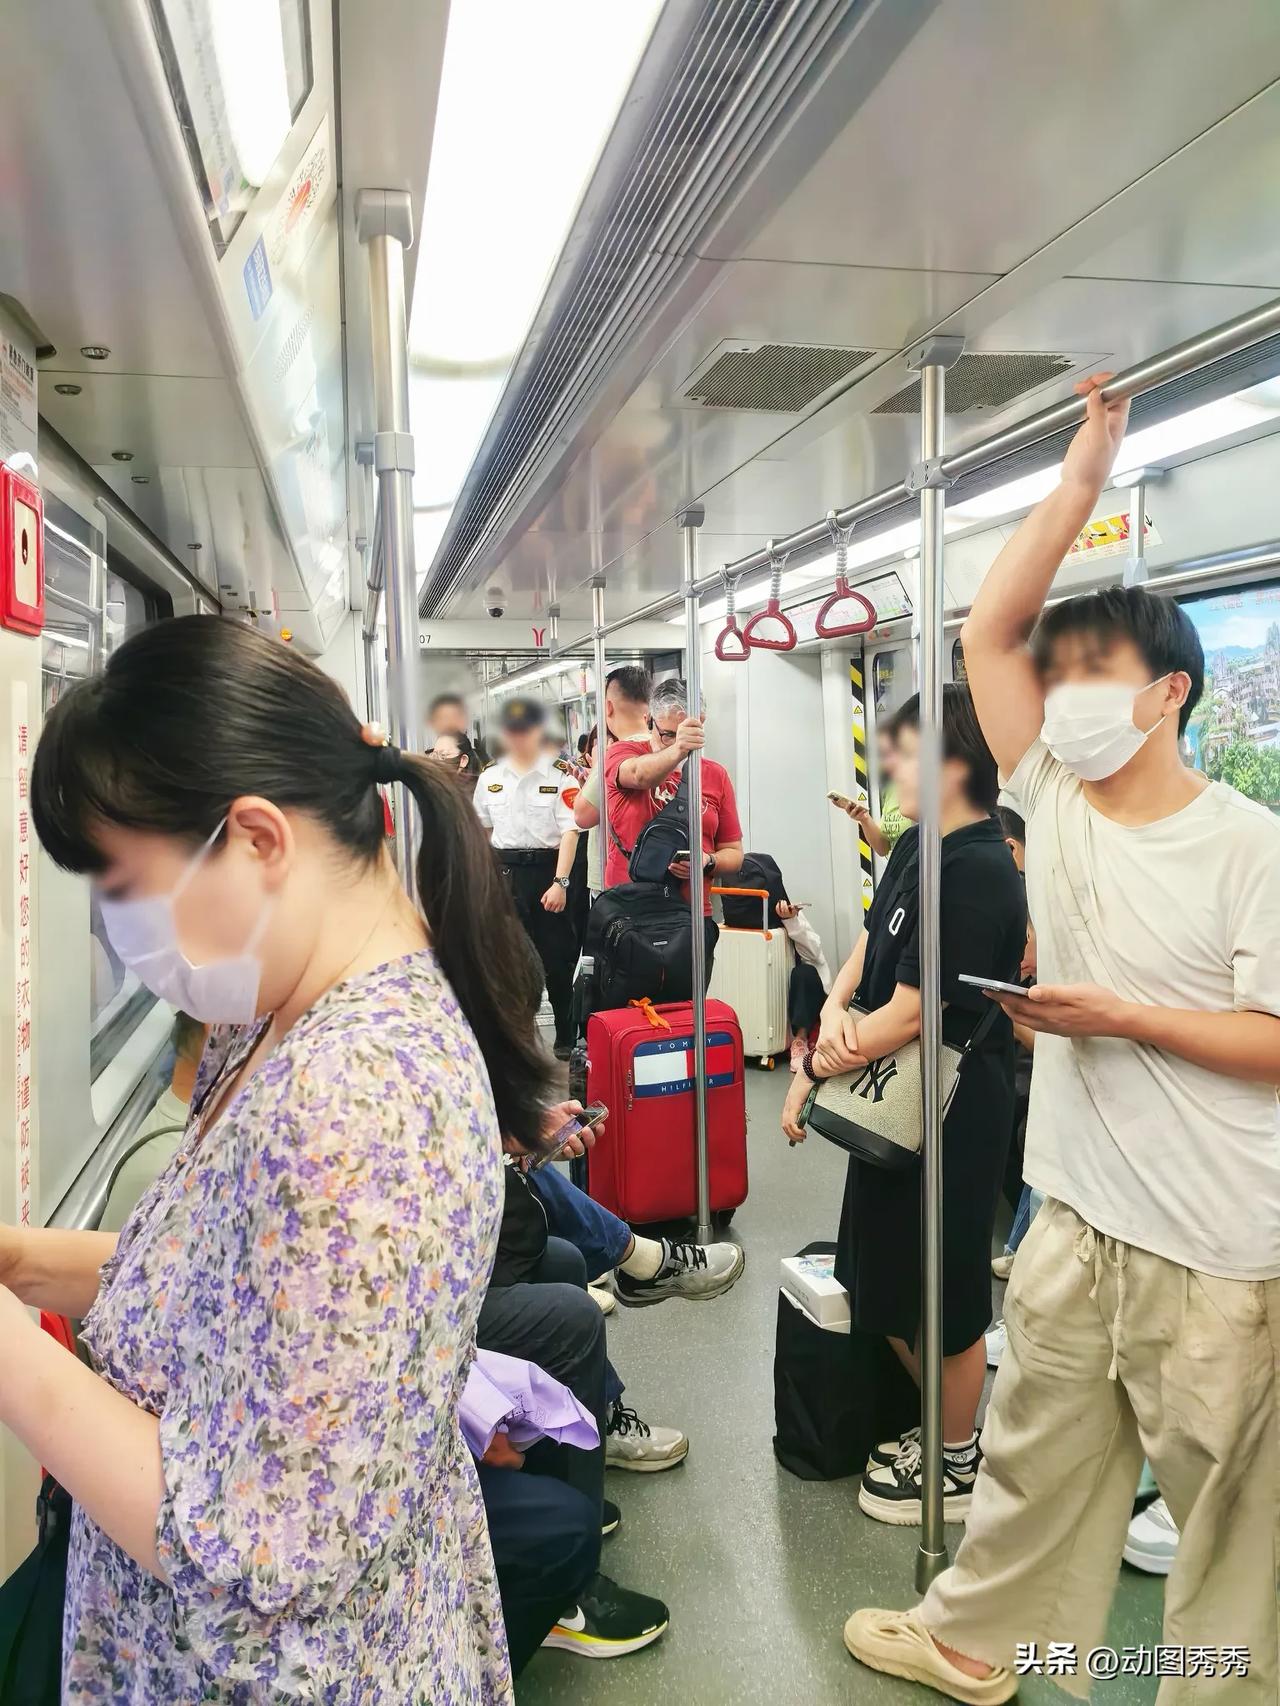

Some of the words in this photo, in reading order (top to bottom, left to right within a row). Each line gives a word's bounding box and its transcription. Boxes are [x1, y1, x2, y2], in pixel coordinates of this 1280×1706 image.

[657, 1037, 713, 1051] TOMY
[661, 1077, 714, 1093] HILFIR
[849, 1055, 898, 1104] NY
